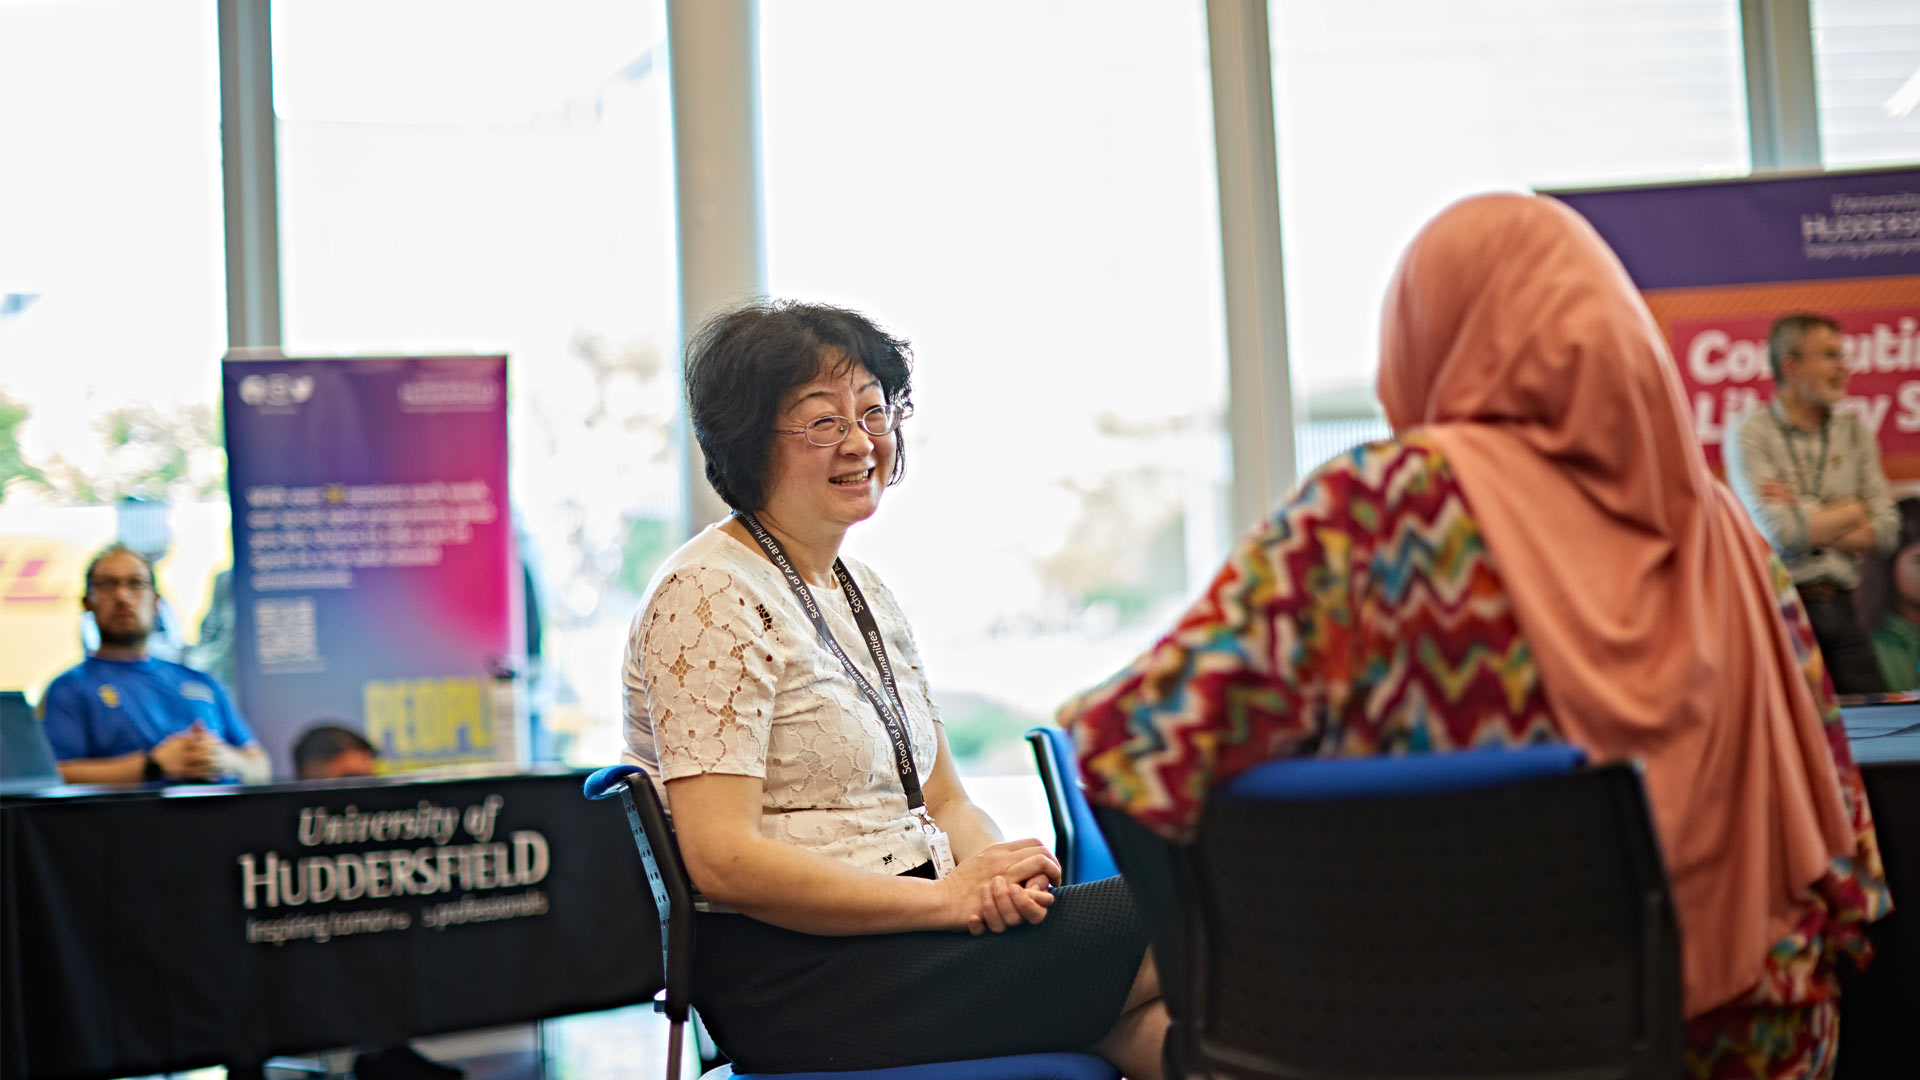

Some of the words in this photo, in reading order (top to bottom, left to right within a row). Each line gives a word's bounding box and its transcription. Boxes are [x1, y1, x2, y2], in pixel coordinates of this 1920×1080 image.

[761, 537, 780, 555] and
[776, 555, 794, 574] Arts
[788, 575, 801, 586] of
[837, 571, 848, 581] of
[796, 585, 820, 619] School
[843, 582, 864, 613] School
[868, 630, 893, 686] Humanities
[866, 689, 883, 706] and
[881, 706, 896, 727] Arts
[890, 728, 901, 739] of
[895, 739, 912, 775] School
[298, 800, 460, 845] University
[463, 794, 504, 842] of
[238, 830, 550, 910] HUDDERSFIELD
